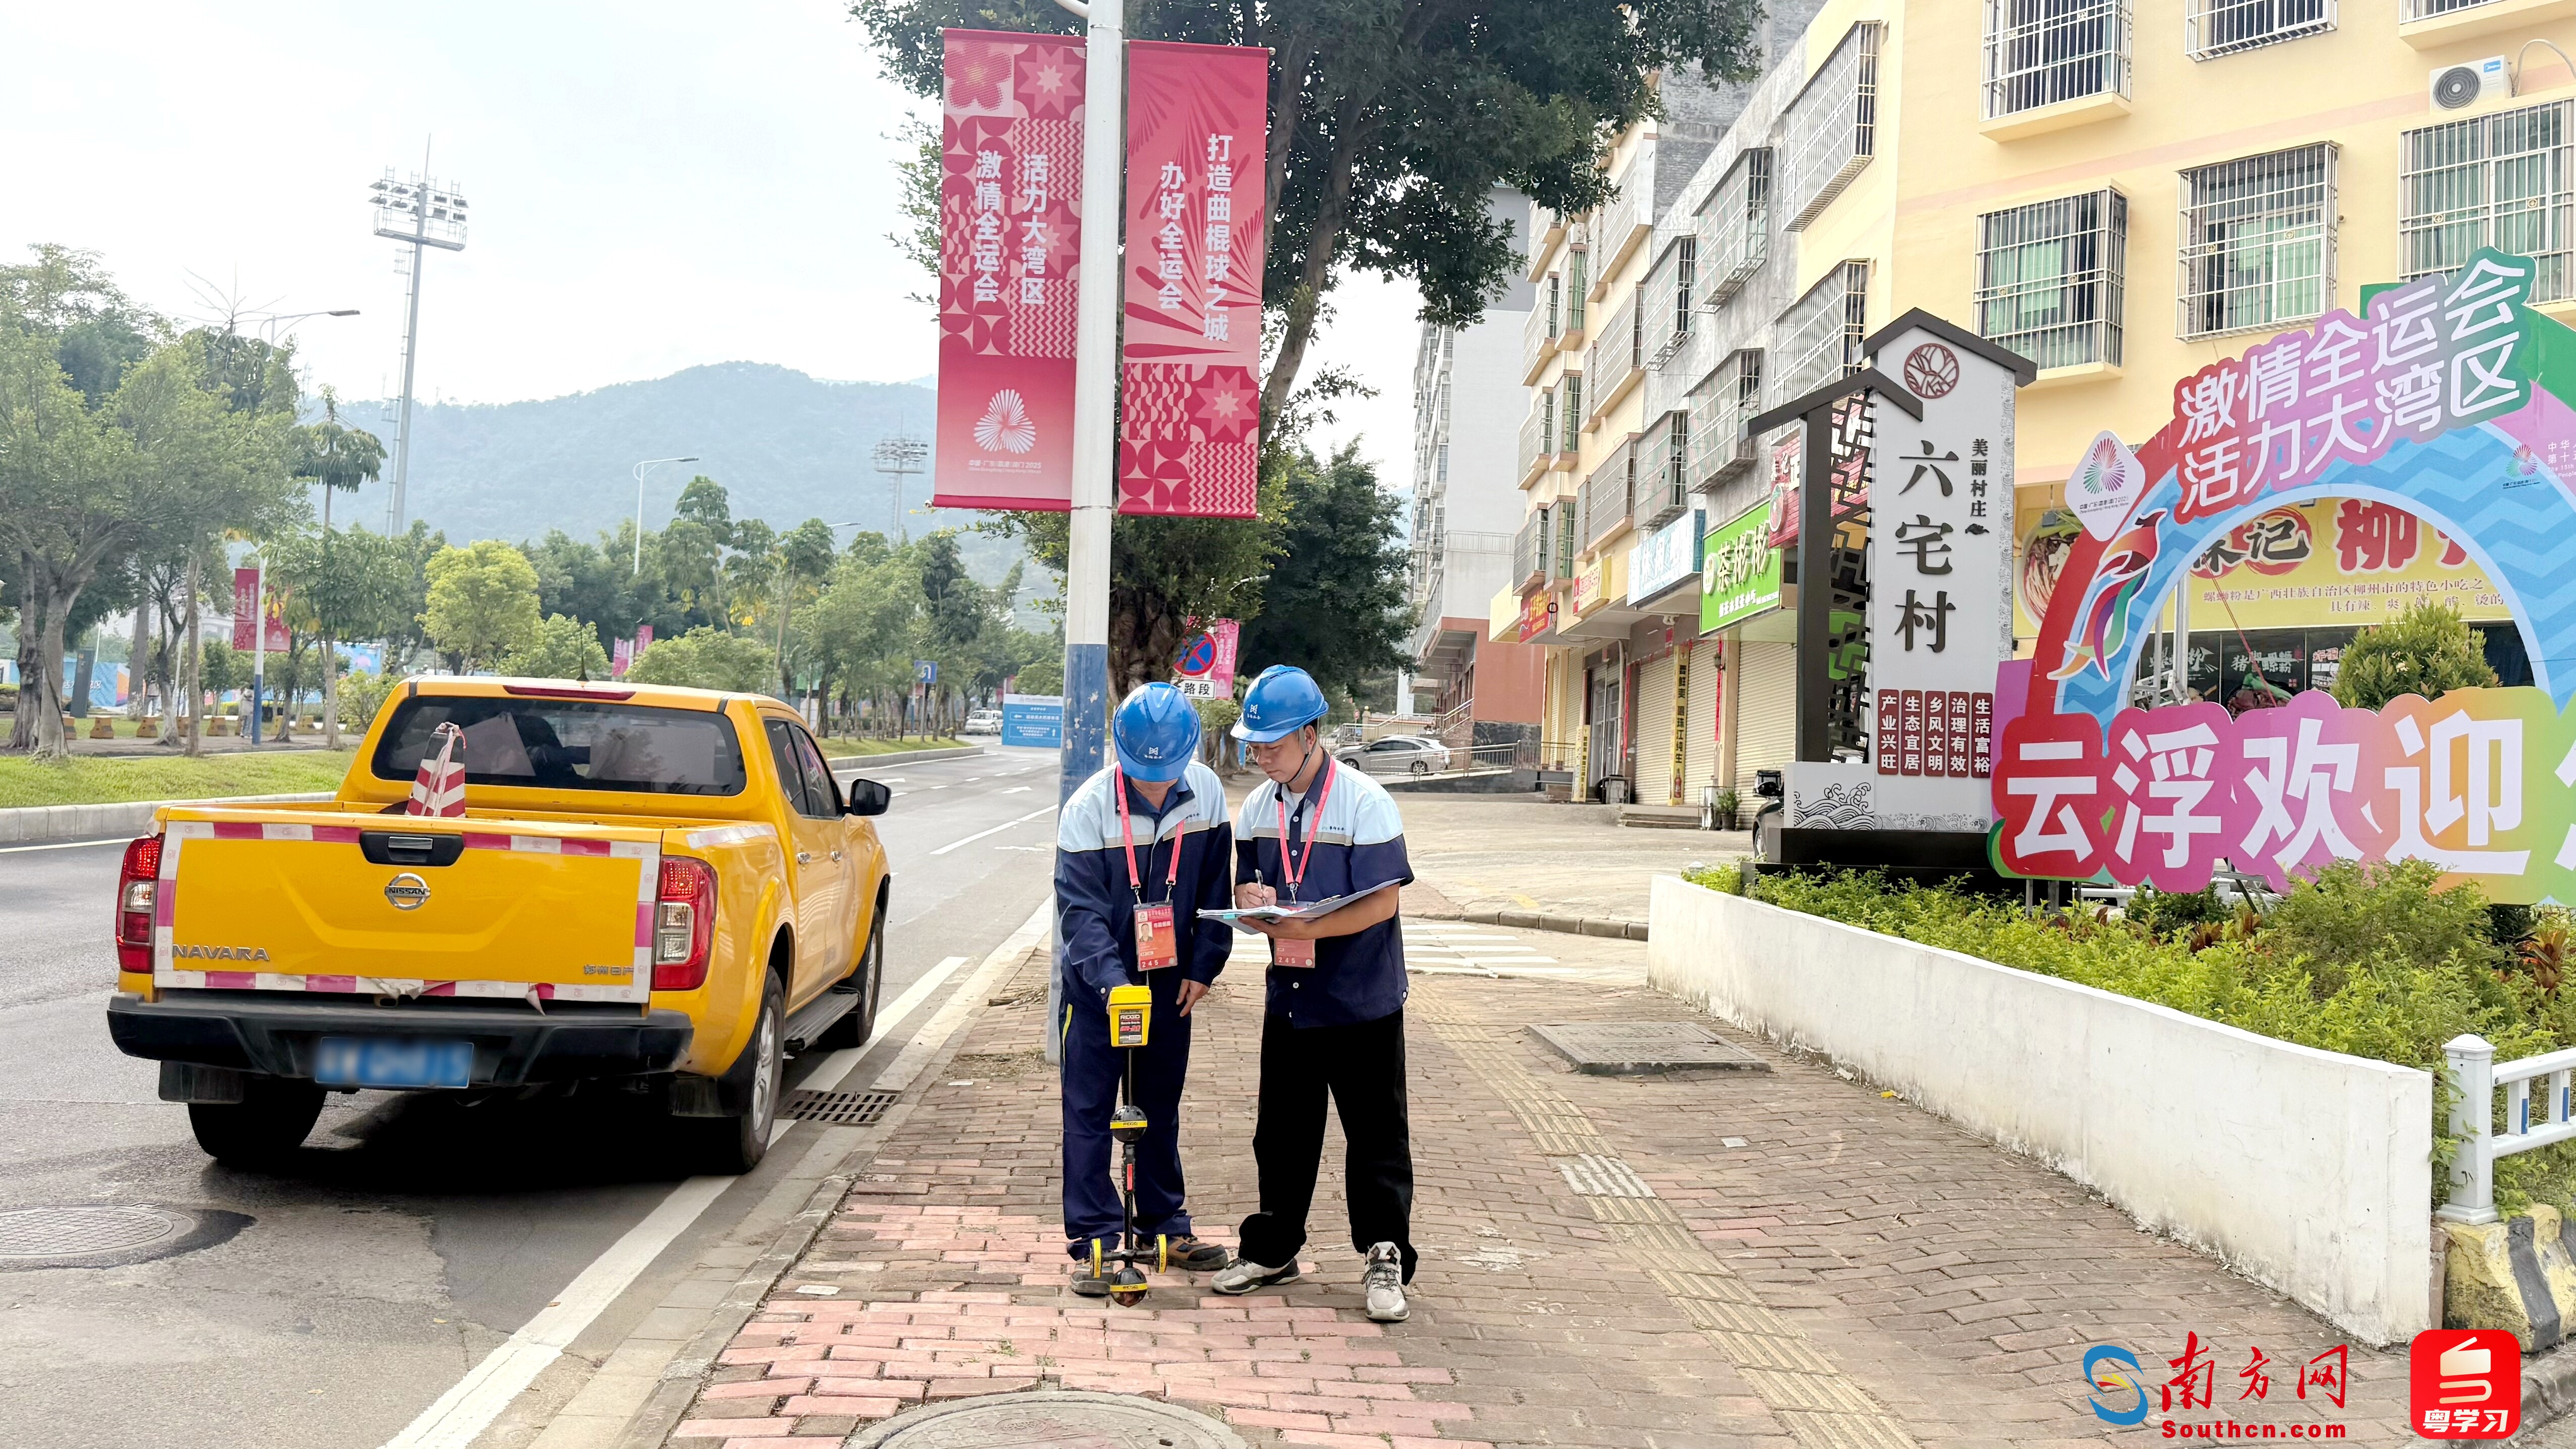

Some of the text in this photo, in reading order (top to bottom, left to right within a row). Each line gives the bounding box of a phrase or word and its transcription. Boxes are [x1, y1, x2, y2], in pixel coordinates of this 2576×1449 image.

[974, 149, 1002, 303] 激情全运会
[1021, 153, 1048, 305] 活力大湾区
[1157, 161, 1186, 310] 办好全运会
[1203, 134, 1233, 342] 打造曲棍球之城
[2178, 257, 2526, 448] 激情全运会
[2181, 332, 2519, 513] 活力大湾区
[2548, 439, 2576, 452] 中华
[2548, 451, 2576, 464] 第十
[1970, 438, 1988, 518] 美丽村庄
[1894, 439, 1959, 653] 六宅村
[1178, 682, 1210, 696] 路段
[1881, 695, 1897, 769] 产业兴旺
[1904, 696, 1921, 770] 生态宜居
[1928, 697, 1944, 771] 乡风文明
[1950, 697, 1967, 772] 治理有效
[1974, 698, 1991, 773] 生活富裕
[2007, 708, 2576, 875] 云浮欢迎
[172, 944, 270, 961] NAVARA
